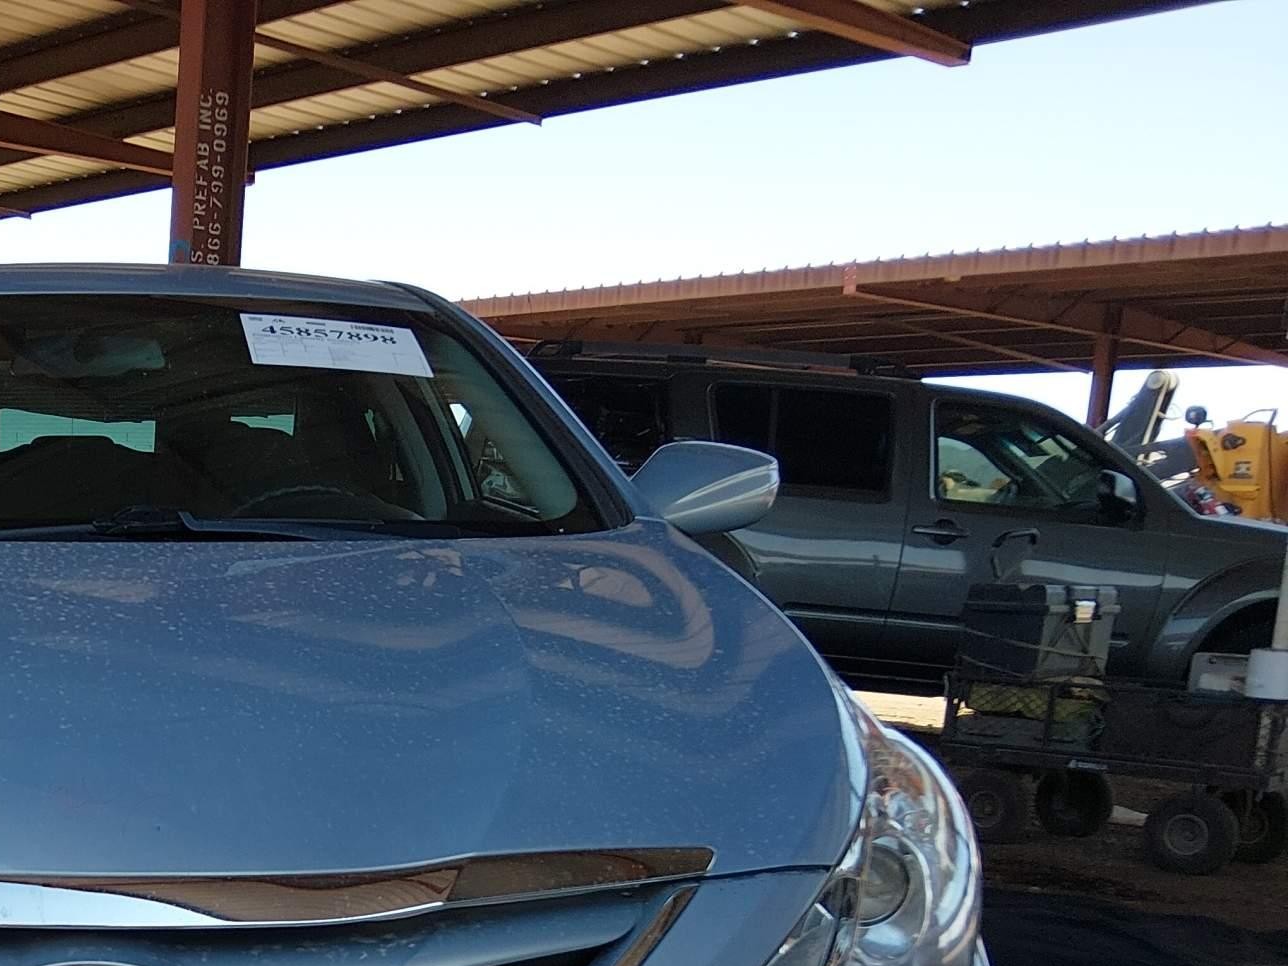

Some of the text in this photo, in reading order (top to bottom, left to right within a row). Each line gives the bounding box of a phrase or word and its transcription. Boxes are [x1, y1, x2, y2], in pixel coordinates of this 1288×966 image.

[199, 88, 213, 130] INC.
[193, 142, 210, 231] PREFAB
[262, 324, 398, 345] 45857898
